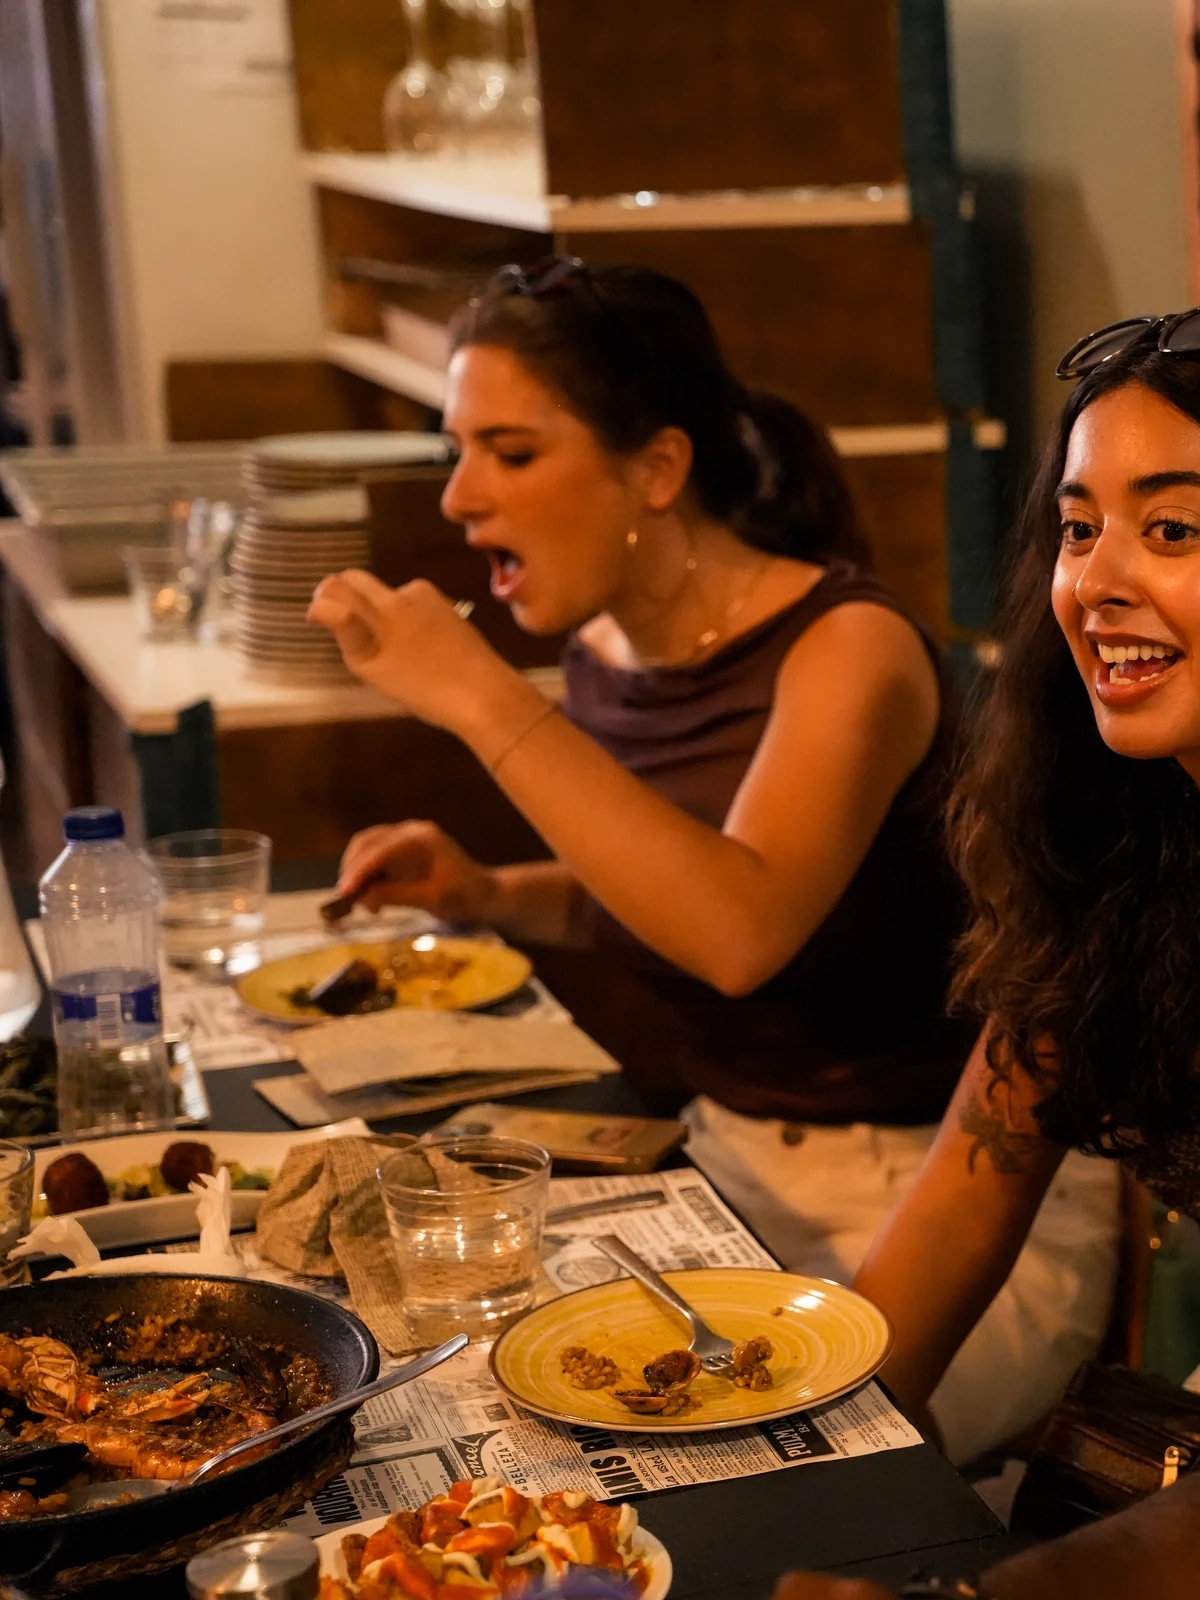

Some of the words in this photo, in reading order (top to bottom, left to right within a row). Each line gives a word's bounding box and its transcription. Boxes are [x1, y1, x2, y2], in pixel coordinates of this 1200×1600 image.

[455, 1436, 488, 1480] oncel
[497, 1446, 528, 1486] BELLEZA
[646, 1454, 669, 1474] usted
[311, 1474, 363, 1525] NOUR
[664, 1475, 681, 1488] Lea
